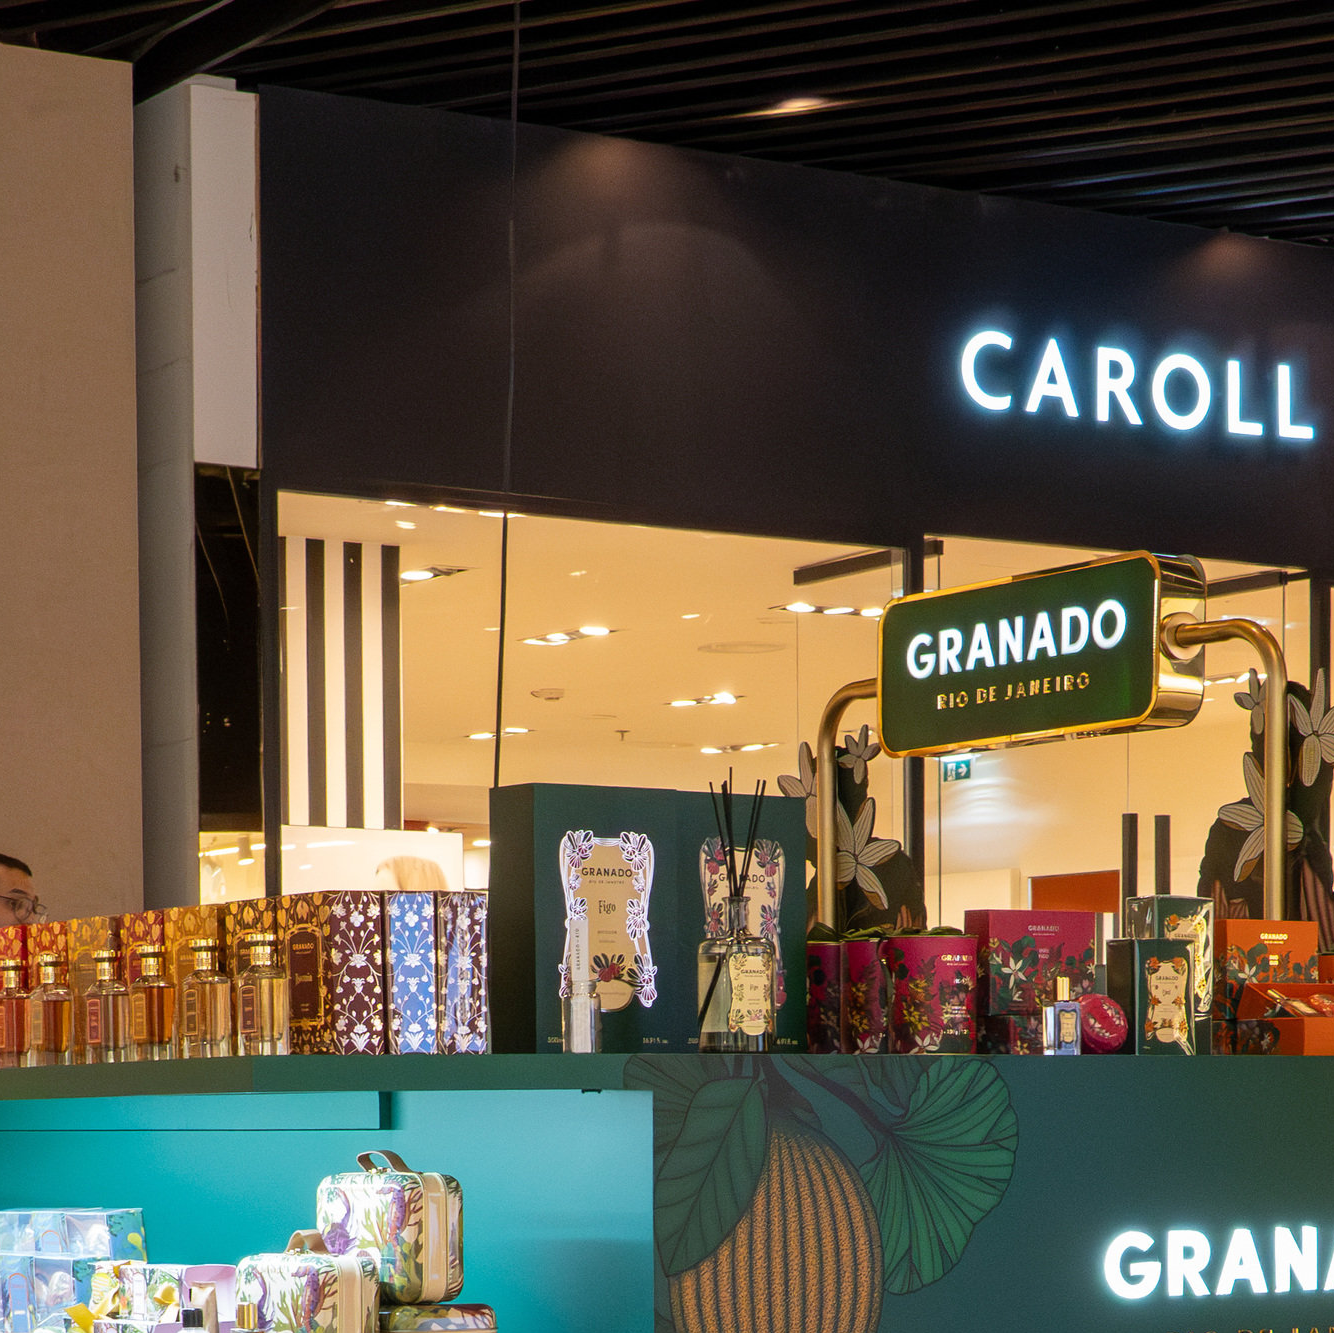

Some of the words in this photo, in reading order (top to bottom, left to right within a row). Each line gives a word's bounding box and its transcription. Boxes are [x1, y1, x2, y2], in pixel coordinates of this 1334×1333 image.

[960, 330, 1314, 440] CAROLL
[905, 598, 1128, 680] GRANADO
[936, 692, 969, 710] RIO
[976, 687, 997, 705] DE
[1004, 671, 1091, 701] JANEIRO
[582, 867, 633, 878] GRANADO
[598, 900, 617, 915] Figo
[1260, 932, 1289, 940] GRANADO
